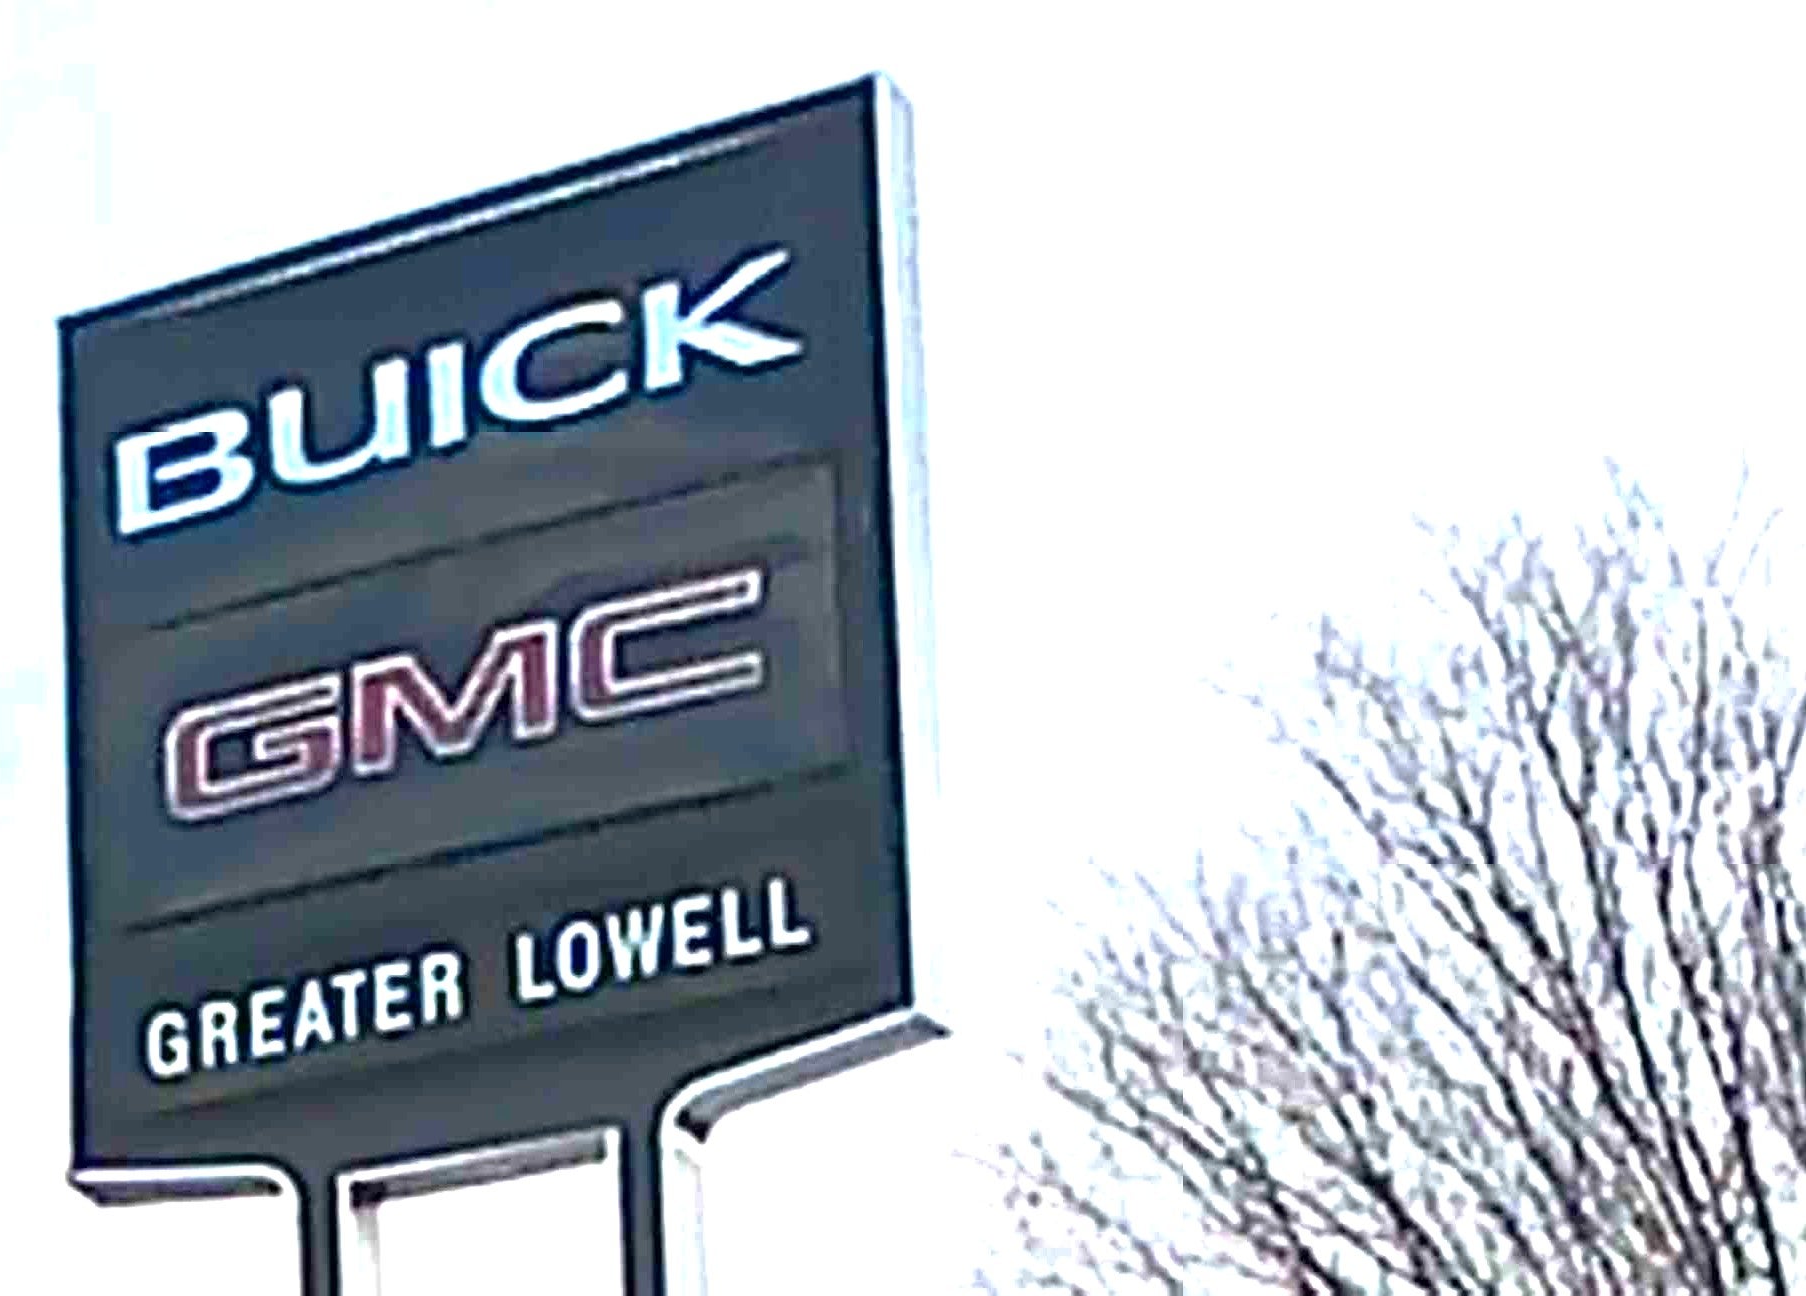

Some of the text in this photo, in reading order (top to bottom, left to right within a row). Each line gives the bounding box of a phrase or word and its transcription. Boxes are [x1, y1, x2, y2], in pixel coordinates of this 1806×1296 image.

[114, 249, 801, 535] BUICK
[166, 568, 764, 819] GMC
[147, 879, 809, 1078] GREATER LOWELL
